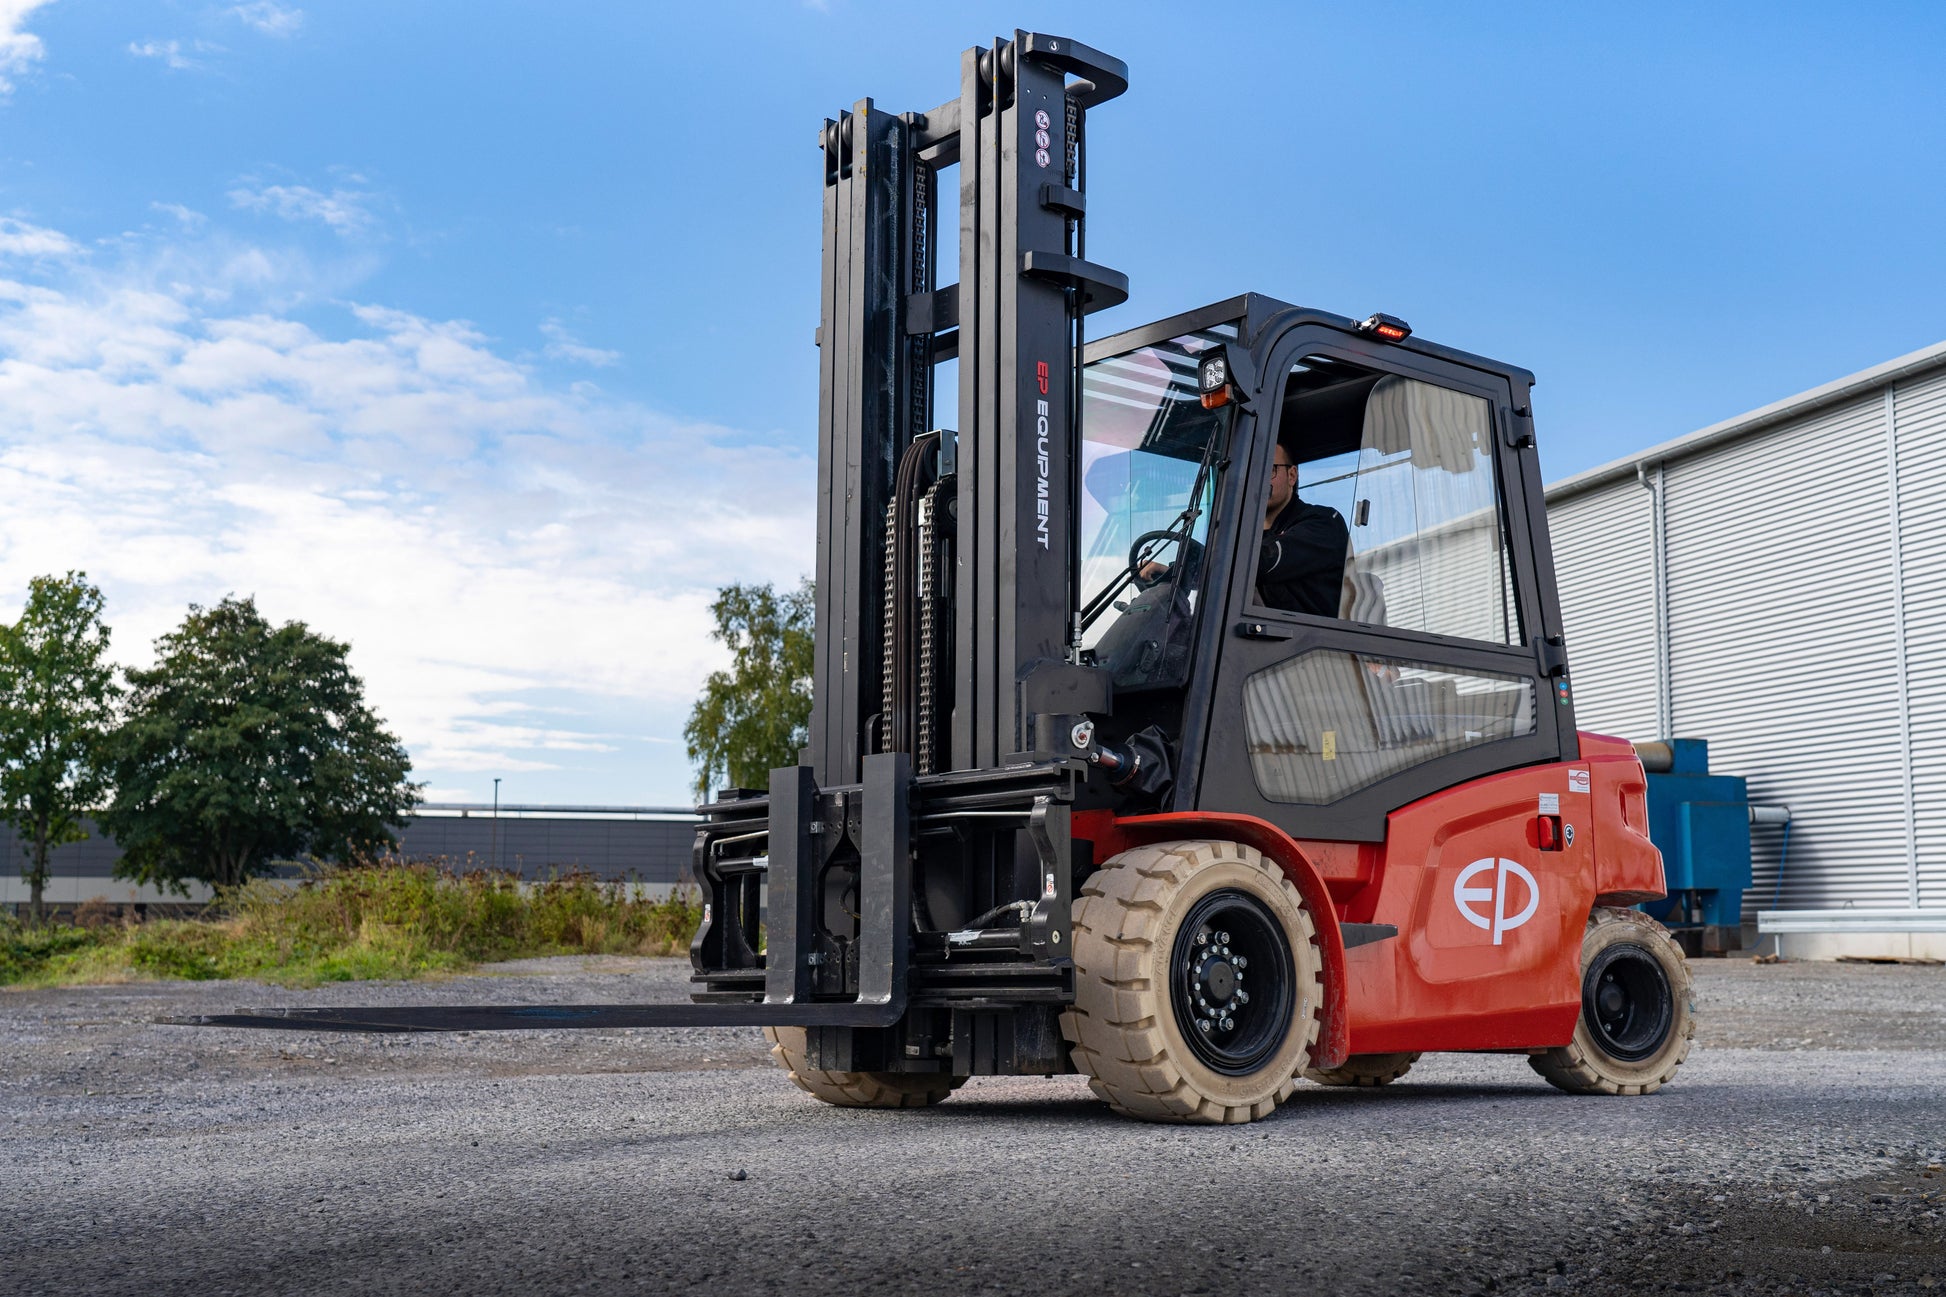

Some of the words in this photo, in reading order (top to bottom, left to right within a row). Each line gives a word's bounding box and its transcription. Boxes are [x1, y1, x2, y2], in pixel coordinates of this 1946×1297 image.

[1037, 361, 1048, 395] EP
[1037, 400, 1048, 550] EQUIPMENT
[1453, 857, 1540, 945] EP
